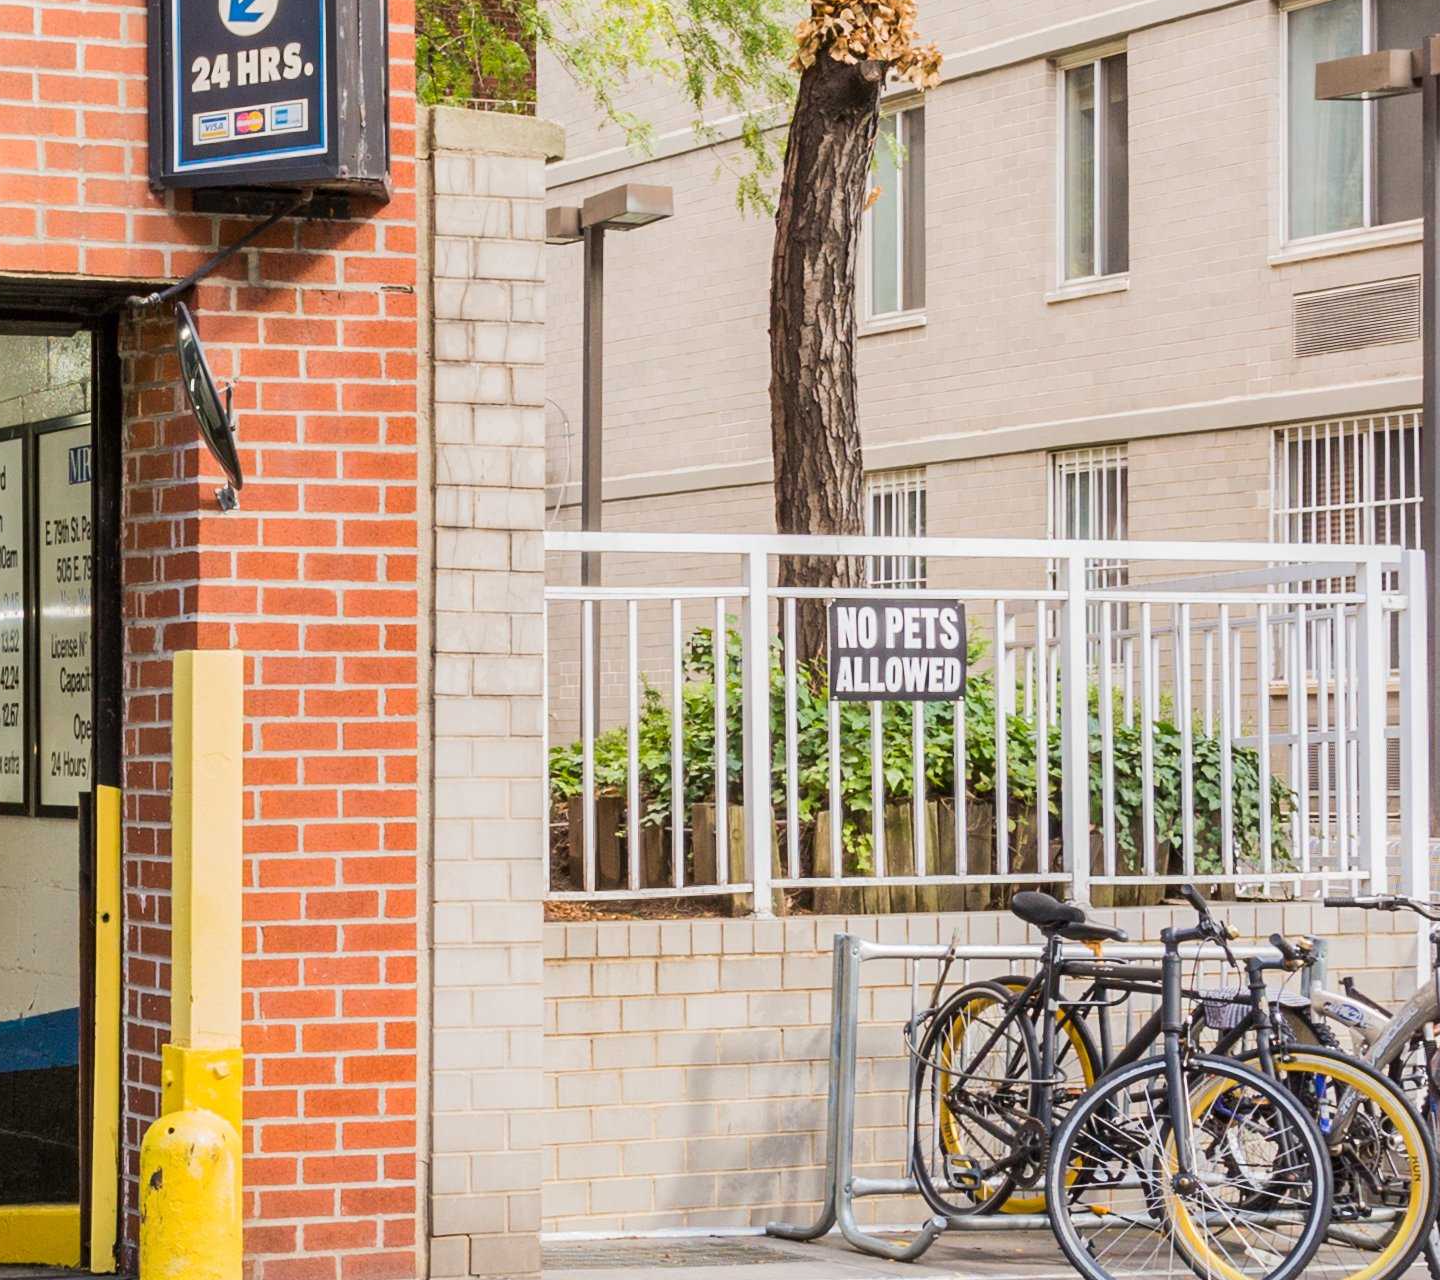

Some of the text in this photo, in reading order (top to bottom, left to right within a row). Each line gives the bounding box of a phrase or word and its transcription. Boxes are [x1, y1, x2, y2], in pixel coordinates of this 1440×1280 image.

[192, 42, 314, 92] 24 HRS.
[54, 518, 70, 544] 79th
[71, 516, 81, 543] St.
[57, 556, 73, 583] 505
[836, 606, 960, 650] NO PETS
[51, 632, 78, 658] License
[836, 656, 962, 693] ALLOWED
[73, 713, 92, 744] Ope
[4, 751, 19, 775] extra
[51, 751, 61, 776] 24
